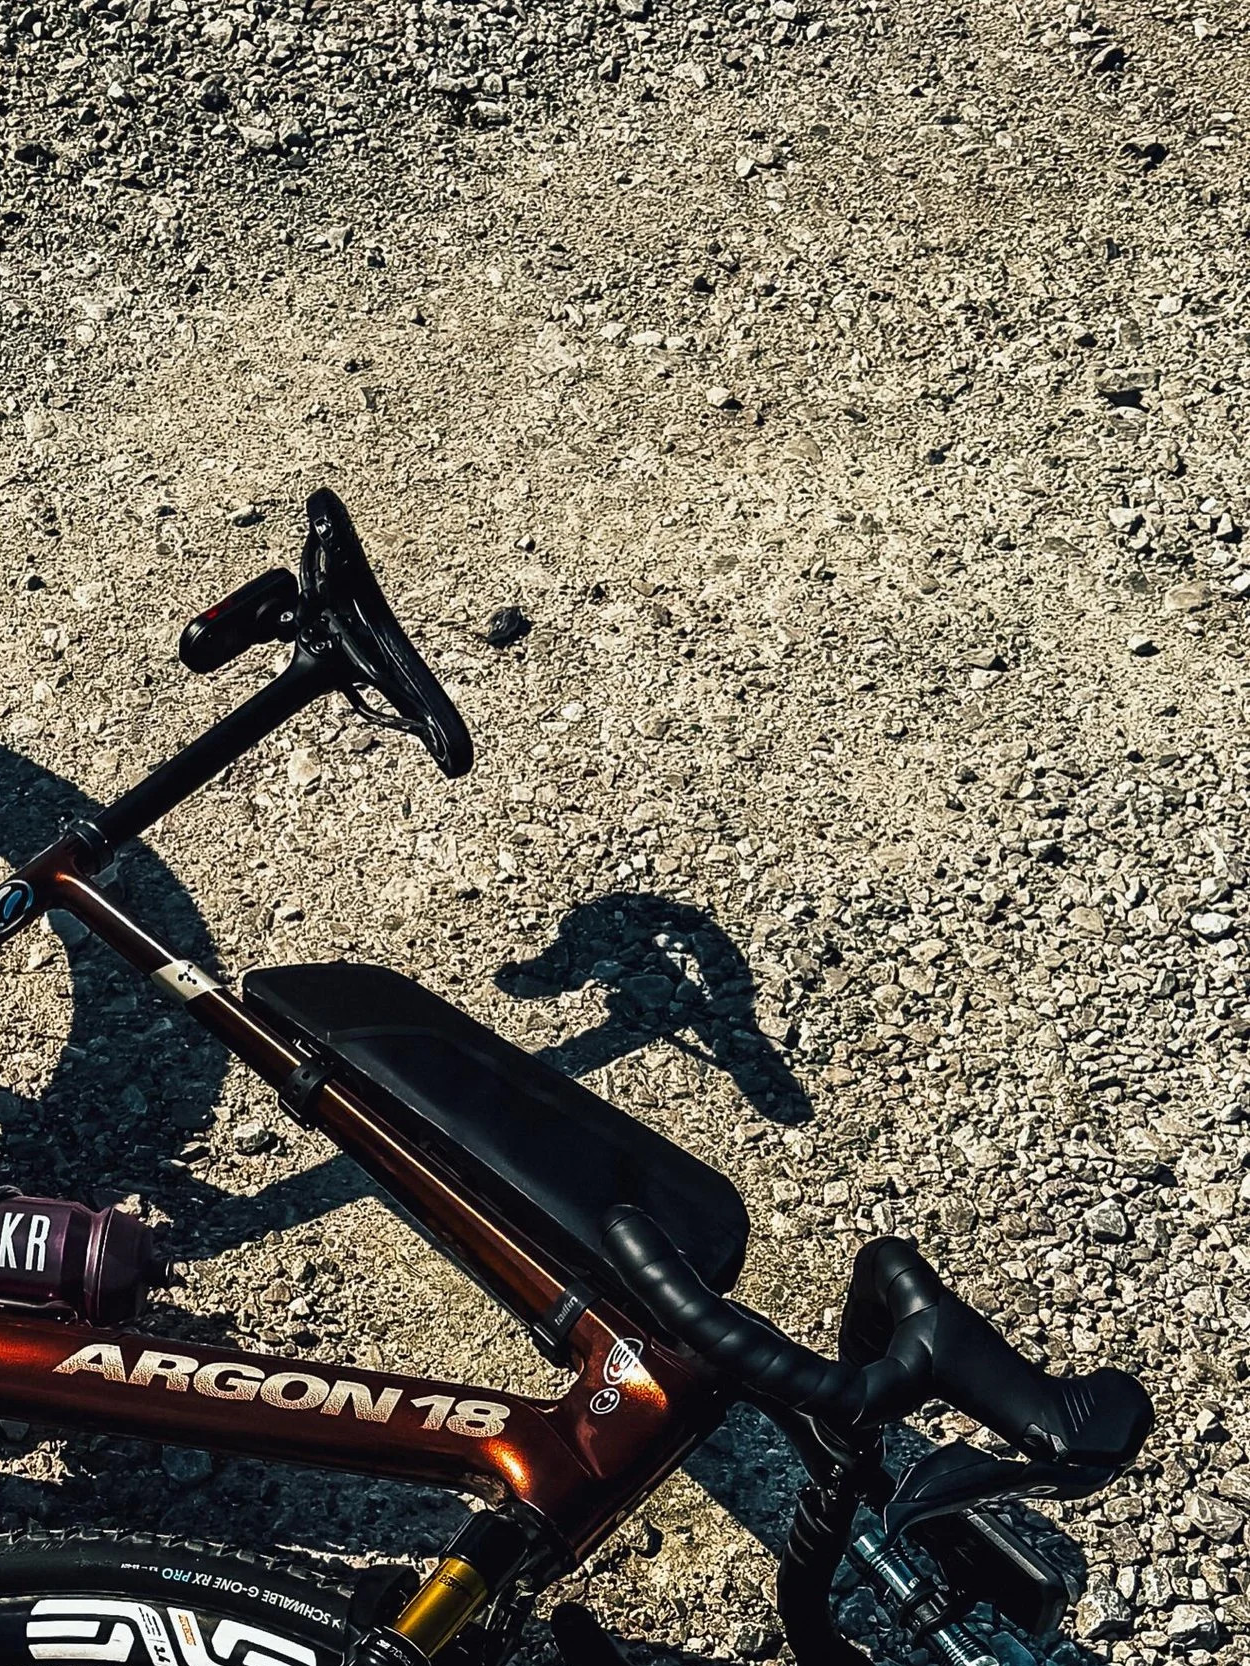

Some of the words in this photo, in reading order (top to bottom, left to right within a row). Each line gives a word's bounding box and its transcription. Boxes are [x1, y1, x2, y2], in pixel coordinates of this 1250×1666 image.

[52, 1343, 404, 1424] ARGON
[410, 1394, 511, 1438] 18
[161, 1567, 192, 1583] PRO
[191, 1571, 213, 1587] RX
[212, 1576, 260, 1598] G-ONE
[261, 1589, 331, 1625] SCHWALBE
